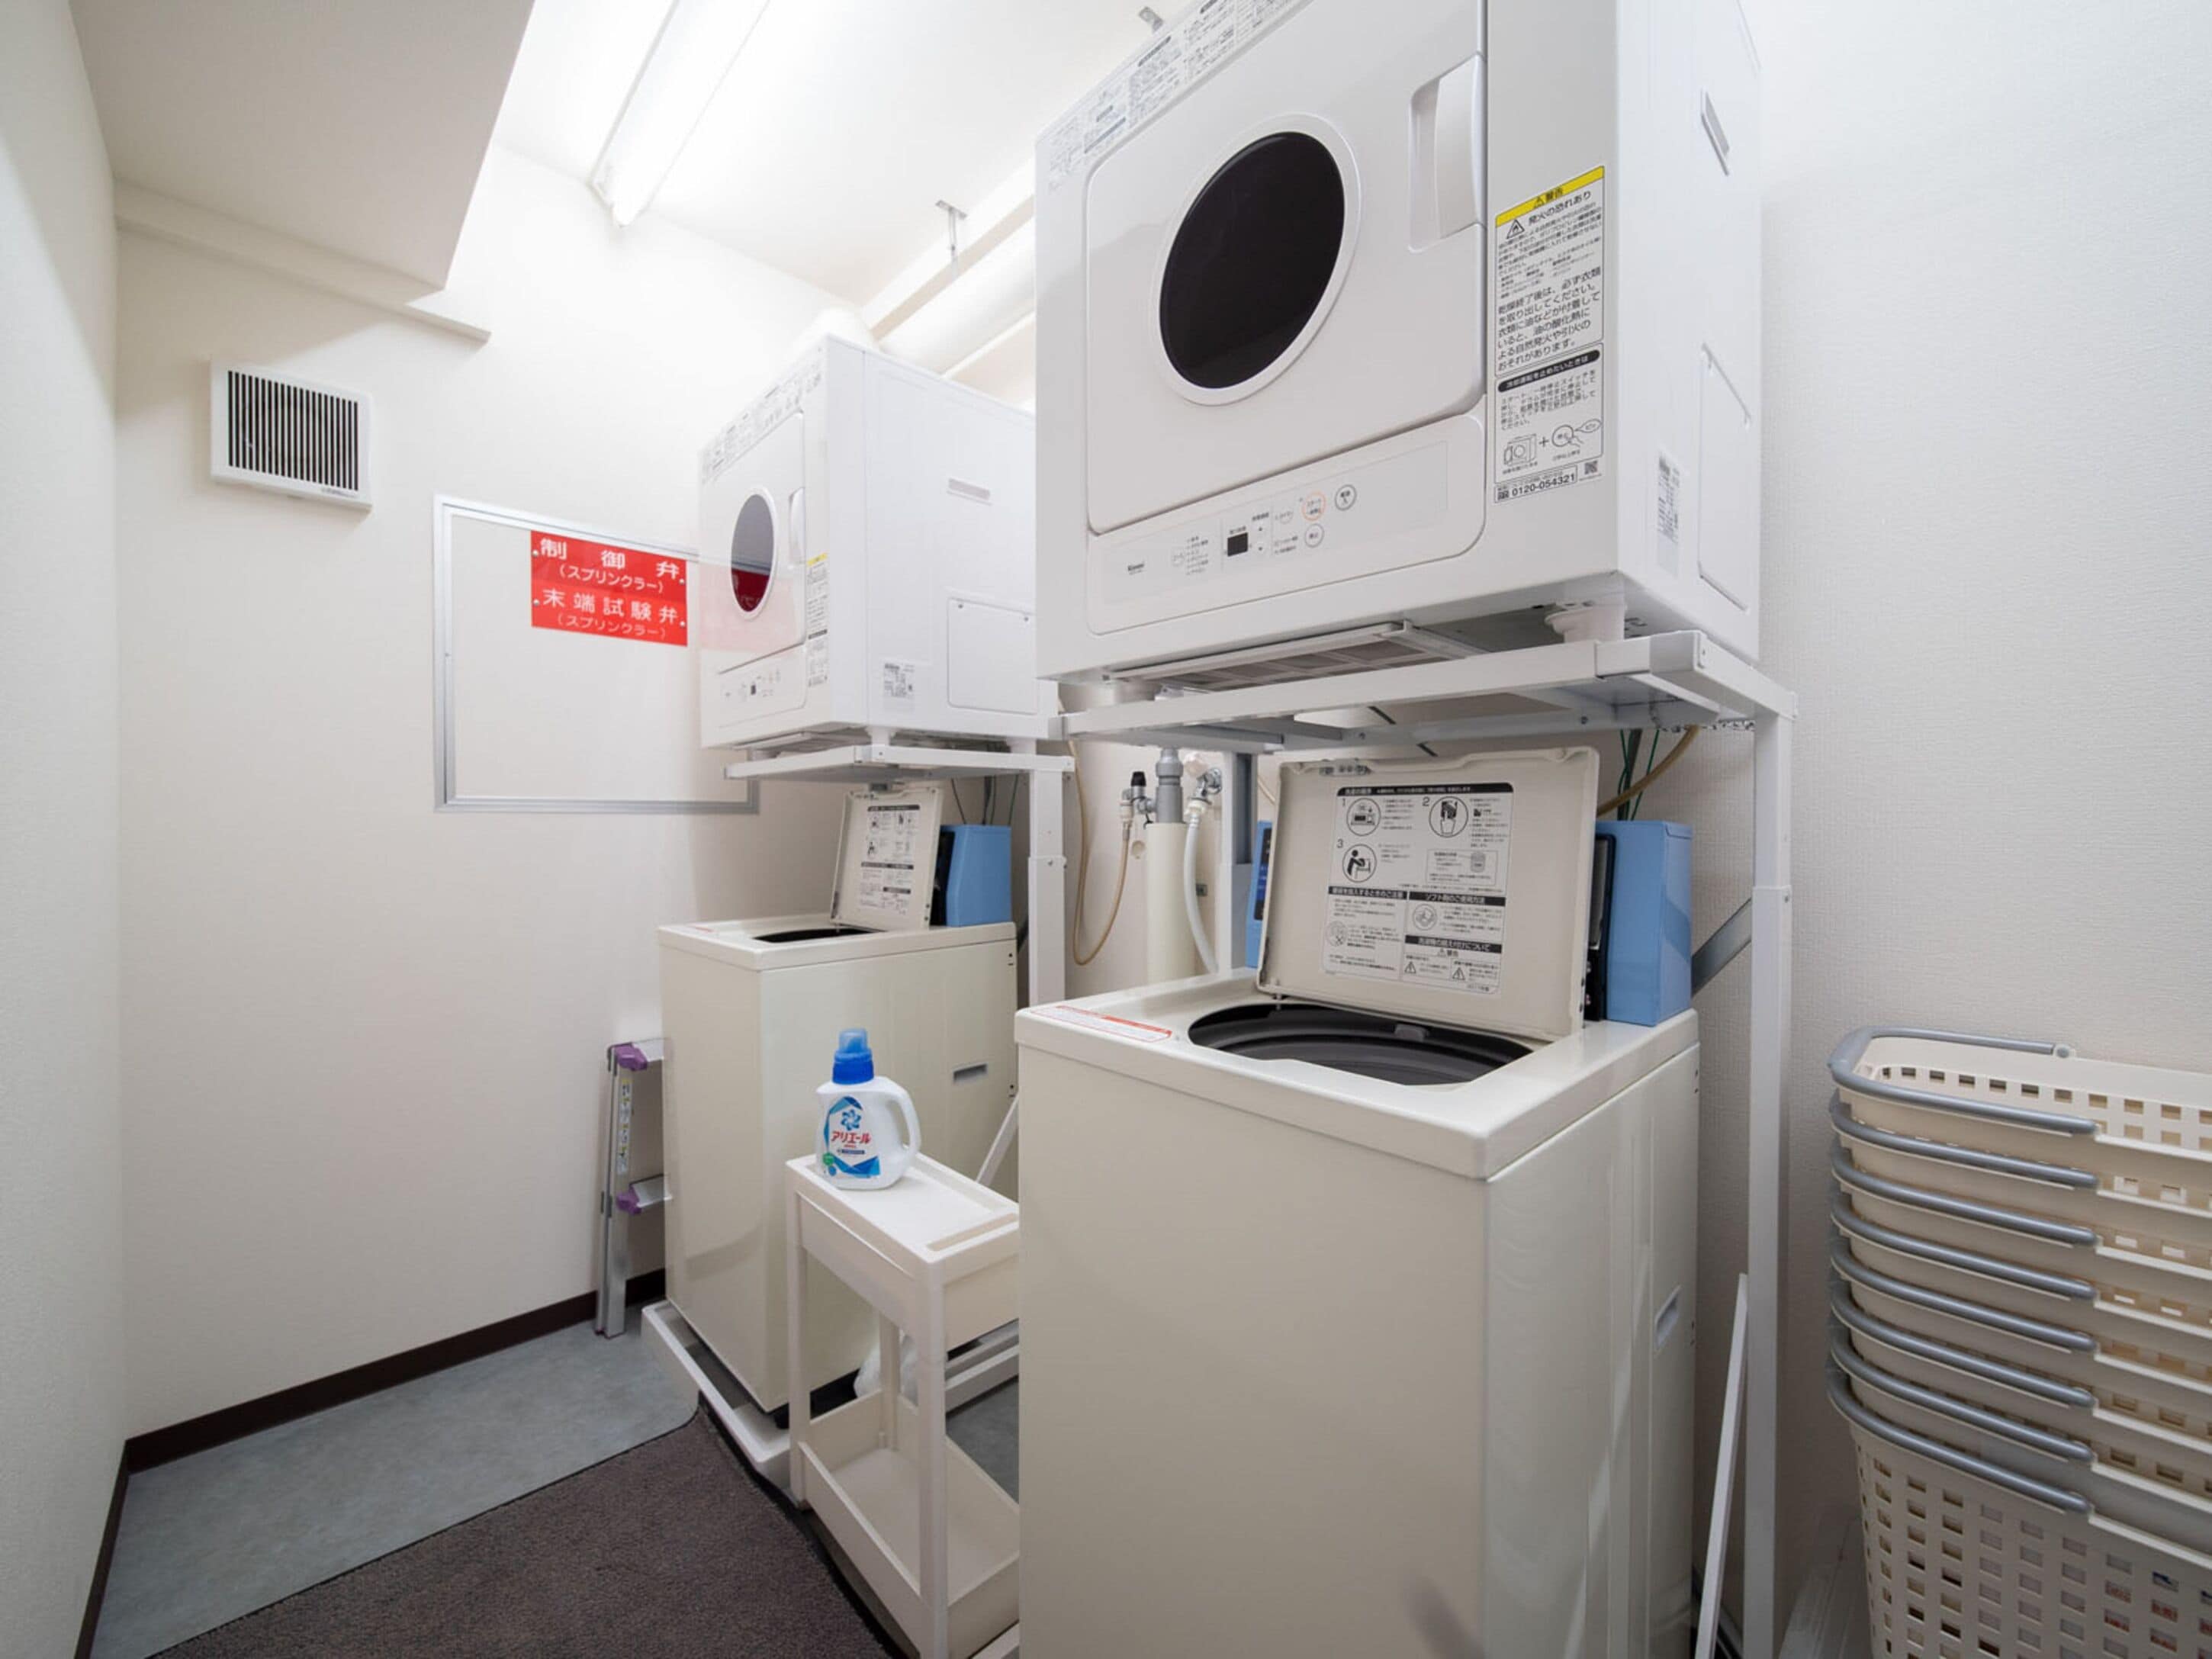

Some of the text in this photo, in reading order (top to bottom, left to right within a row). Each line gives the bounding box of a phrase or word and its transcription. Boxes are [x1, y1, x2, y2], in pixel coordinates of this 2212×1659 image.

[1512, 474, 1575, 497] 0120-054321
[1423, 796, 1430, 806] 2
[1336, 839, 1344, 848] 3
[831, 1130, 871, 1144] アリエール
